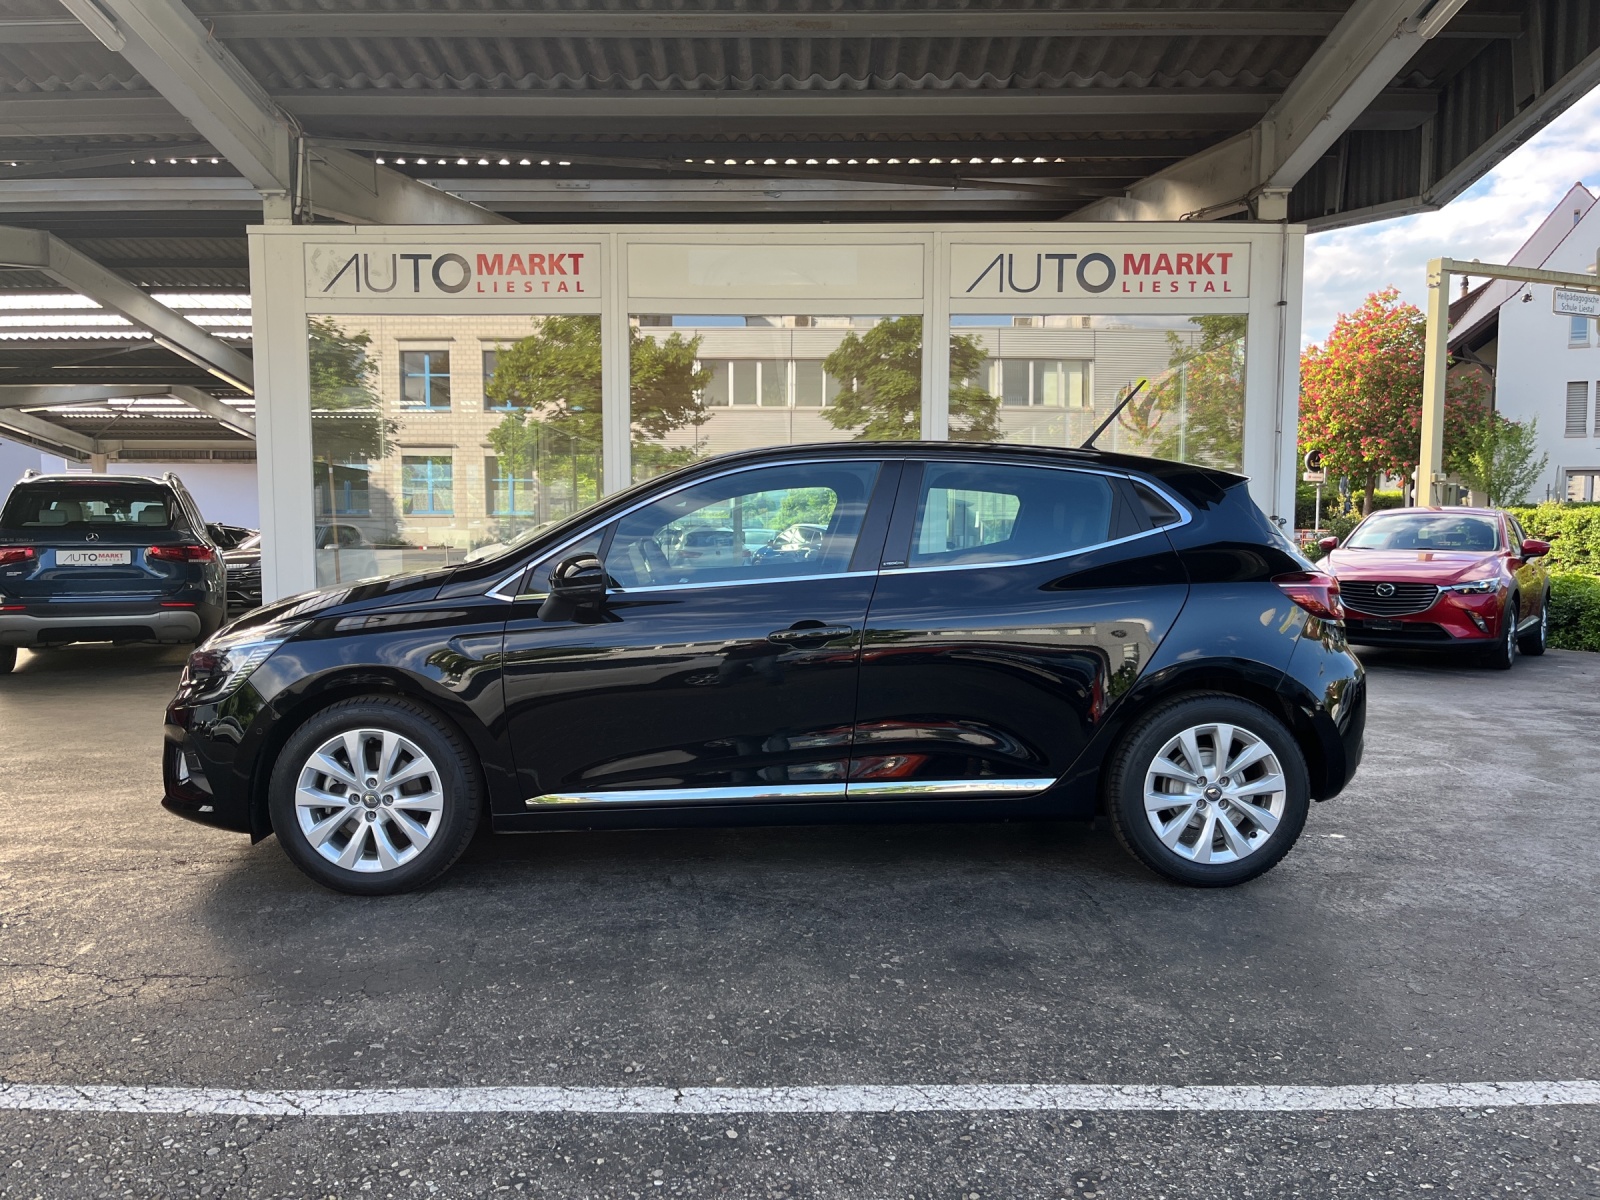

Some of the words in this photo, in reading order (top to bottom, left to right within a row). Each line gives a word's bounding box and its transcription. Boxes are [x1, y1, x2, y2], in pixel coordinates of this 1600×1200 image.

[322, 253, 472, 294] AUTO
[476, 253, 585, 276] MARKT
[965, 252, 1117, 294] AUTO
[1123, 252, 1233, 275] MARKT
[476, 281, 585, 293] LIESTAL
[1122, 281, 1232, 293] LIESTAL
[1557, 292, 1600, 304] Heilpädagogische
[1561, 303, 1578, 312] Schule
[1578, 304, 1595, 313] Liestal
[63, 553, 98, 562] AUTO
[986, 781, 1036, 789] CLIO
